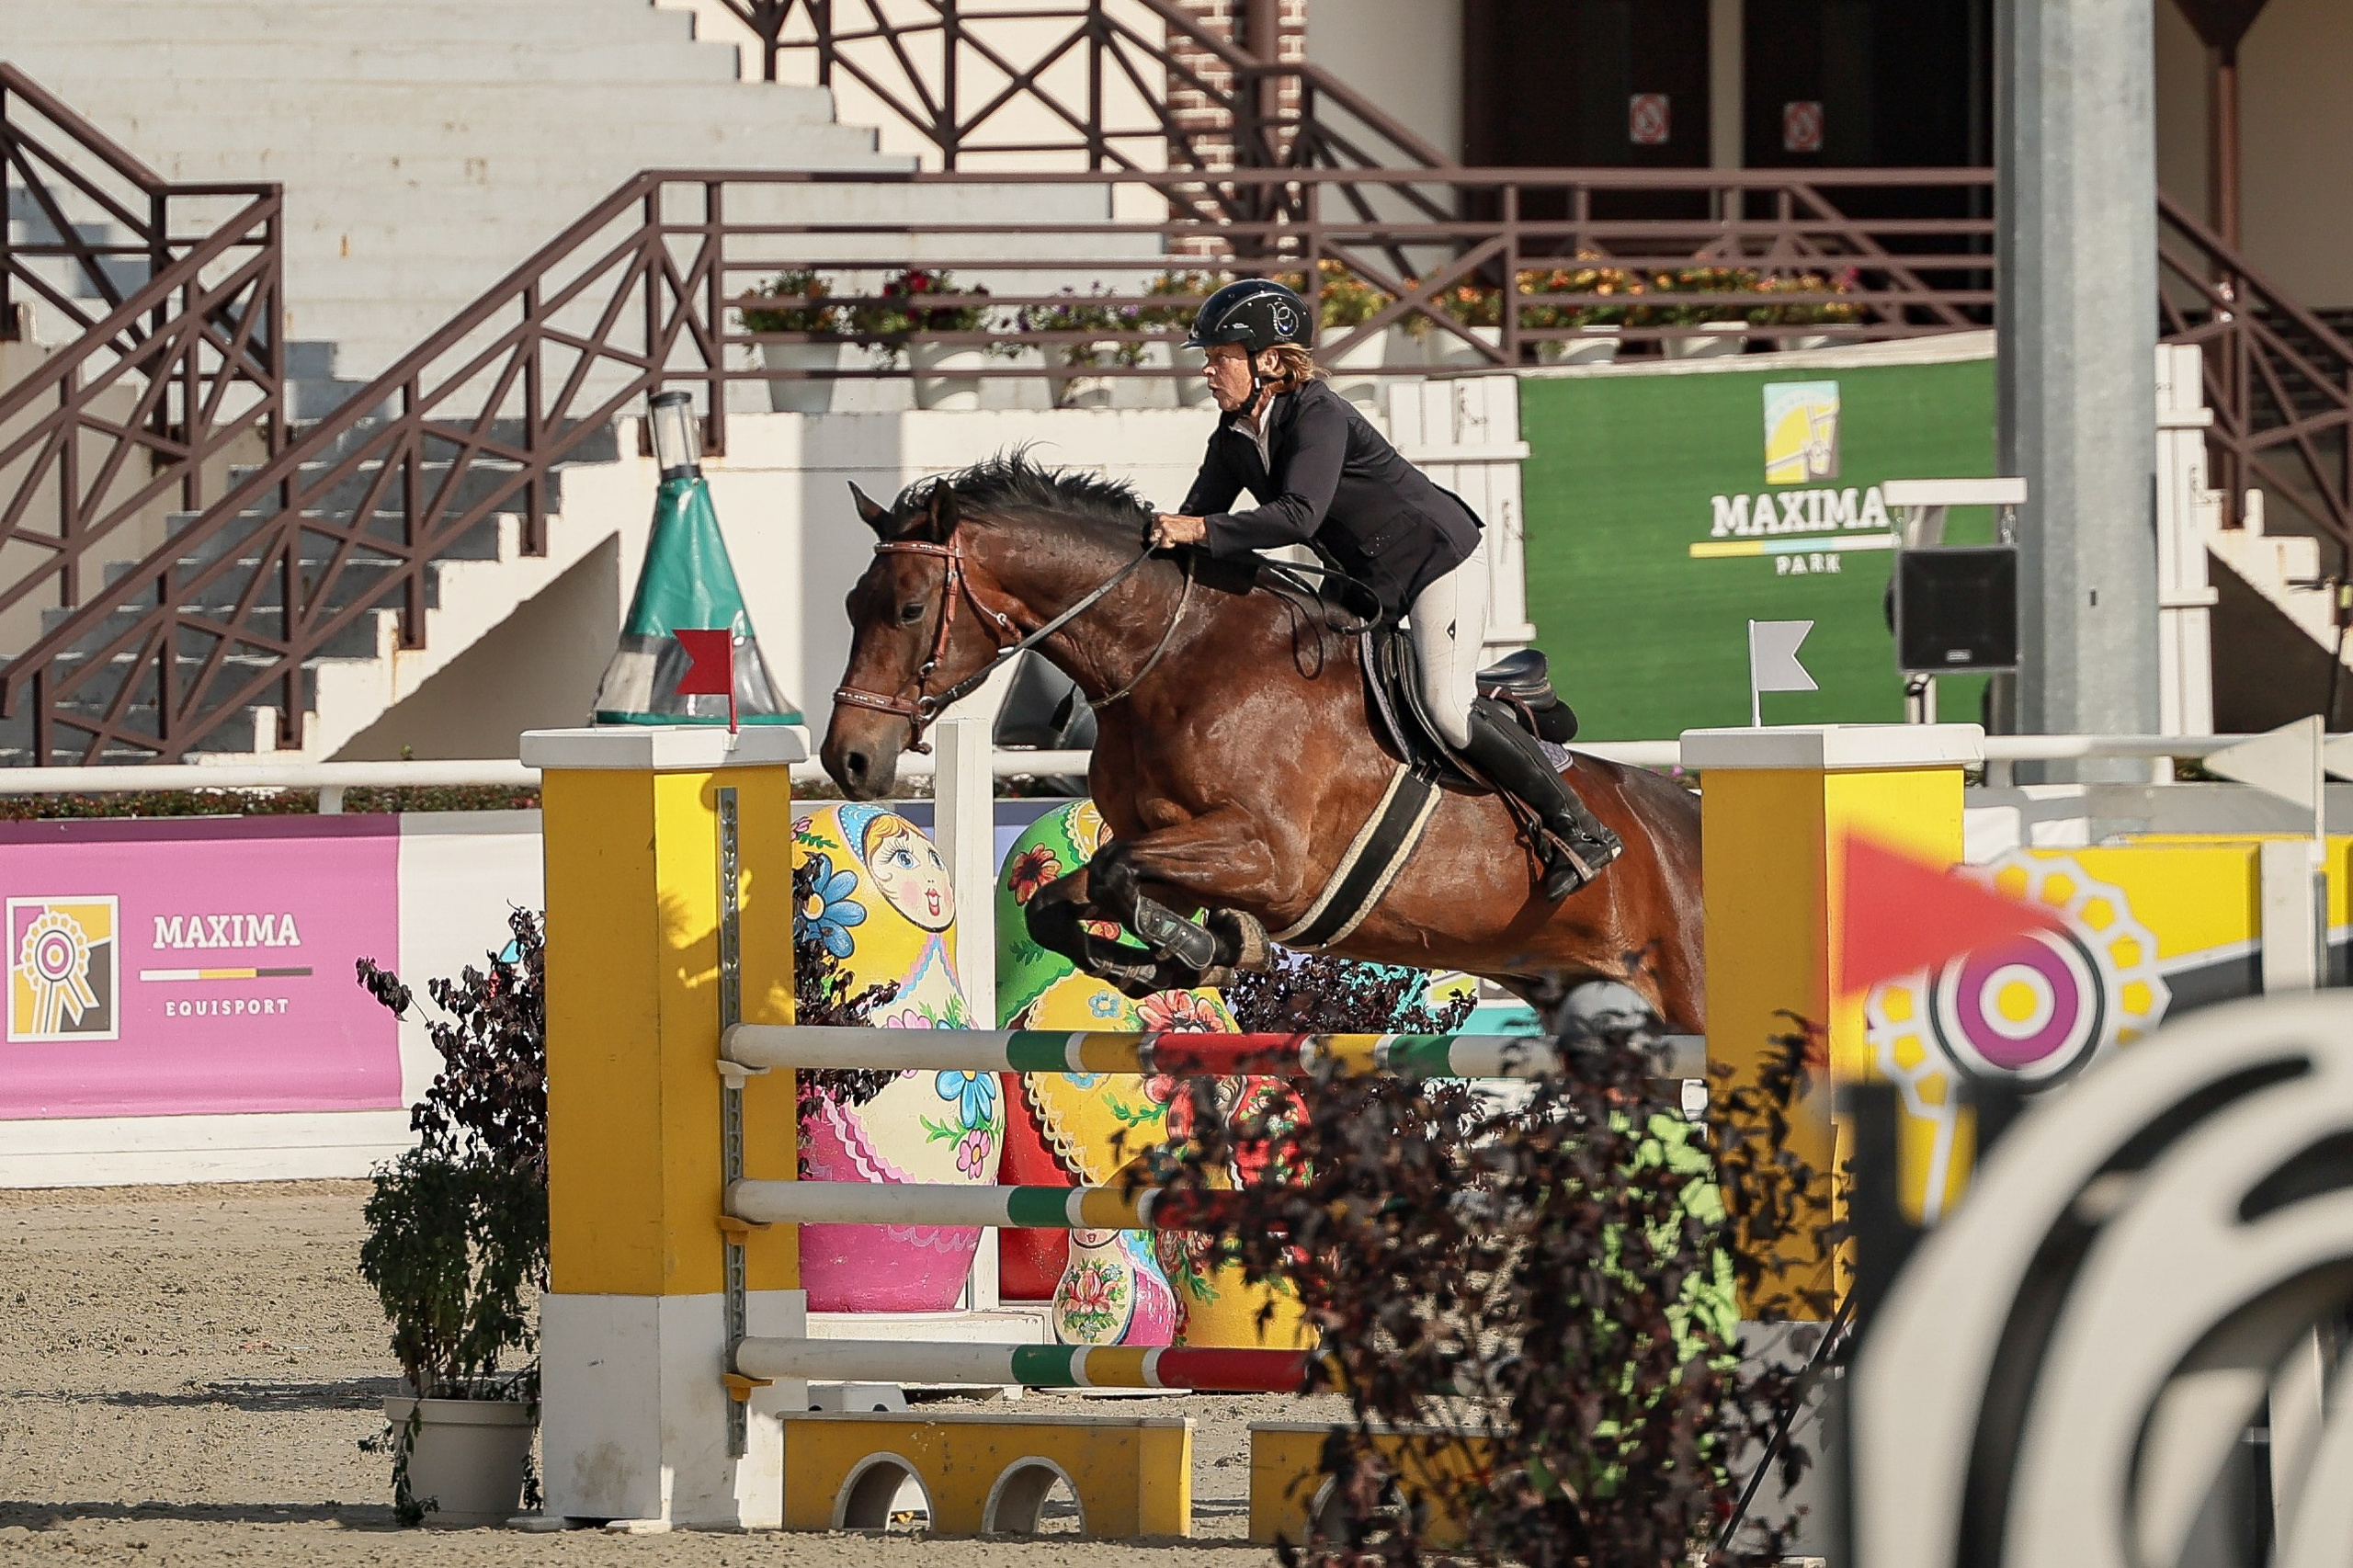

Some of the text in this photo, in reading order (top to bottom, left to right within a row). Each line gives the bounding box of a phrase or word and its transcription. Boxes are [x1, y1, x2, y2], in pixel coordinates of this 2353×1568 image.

[1711, 486, 1890, 537] MAXIMA
[1776, 553, 1841, 576] PARK
[153, 914, 301, 949] MAXIMA
[165, 998, 290, 1017] EQUISPORT
